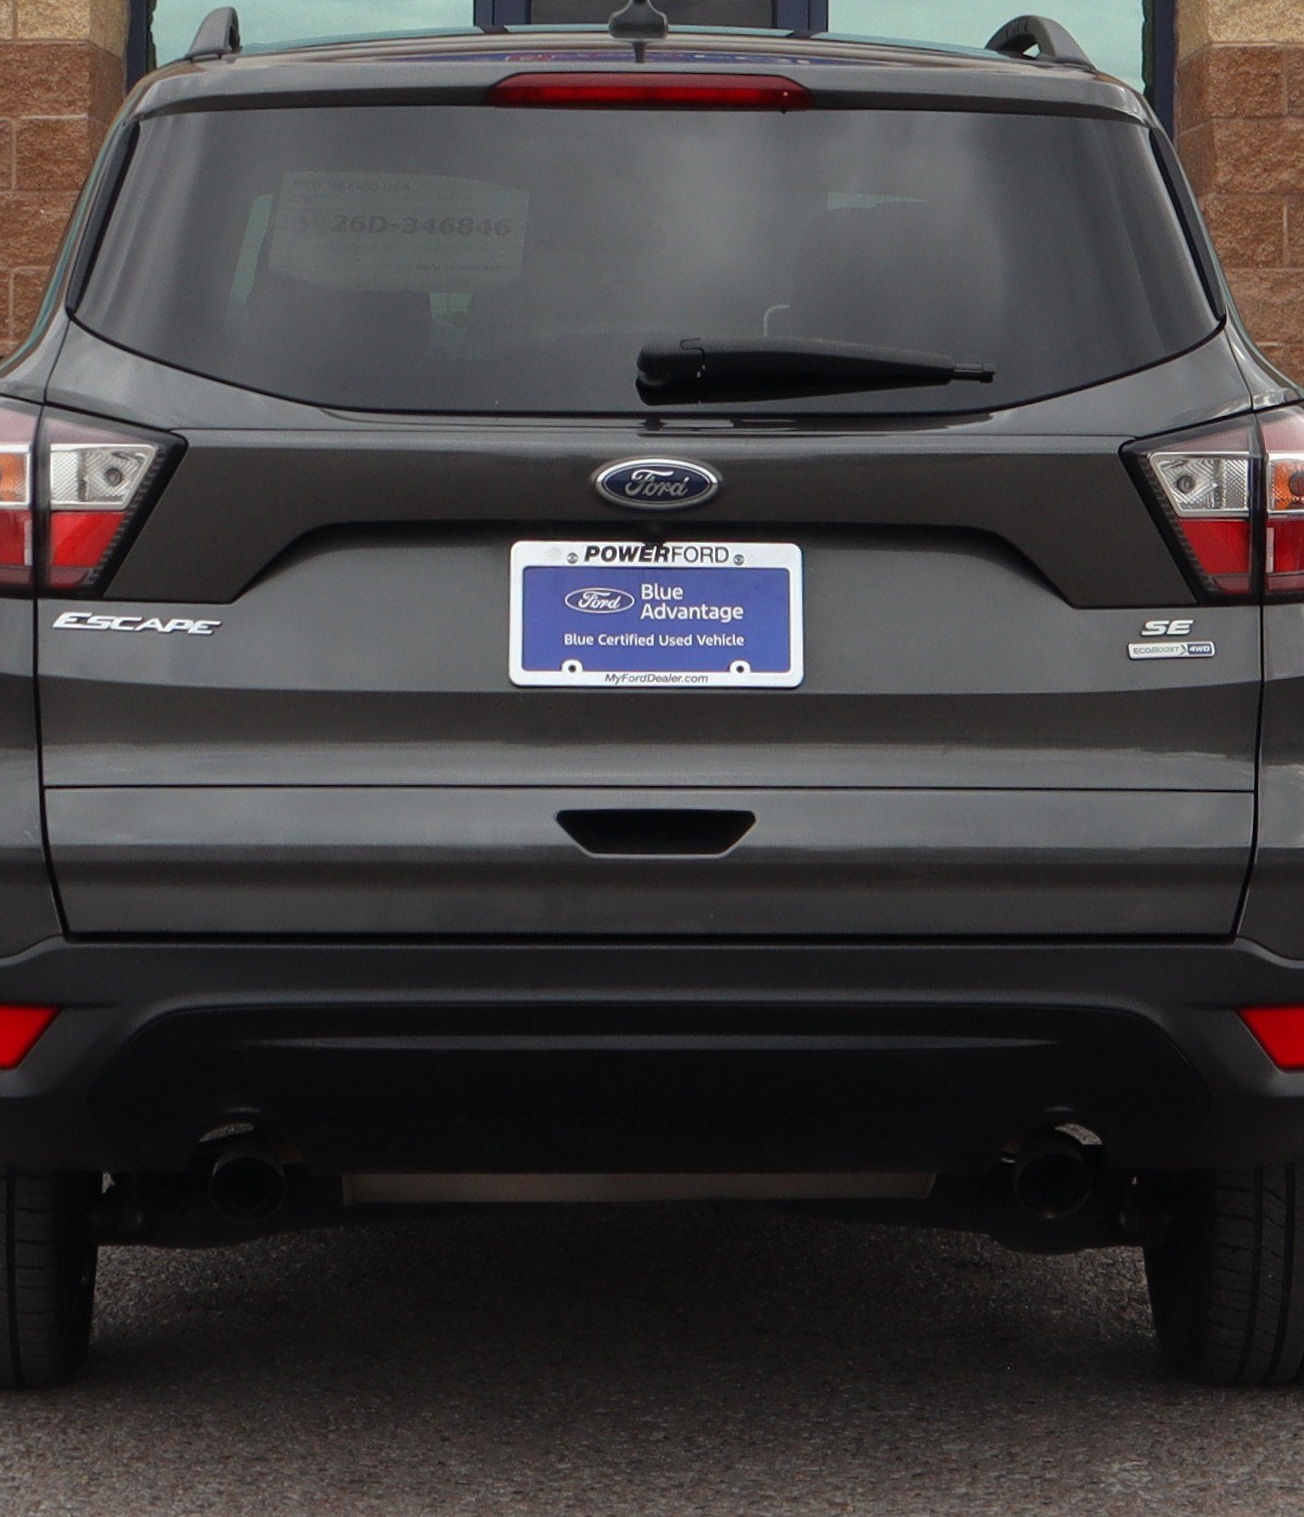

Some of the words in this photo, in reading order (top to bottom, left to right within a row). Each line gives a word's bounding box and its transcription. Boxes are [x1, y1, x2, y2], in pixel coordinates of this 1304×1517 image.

[330, 213, 513, 237] 26D-346846
[624, 469, 689, 497] Ford
[583, 545, 730, 564] POWERFORD
[577, 590, 621, 610] Ford
[640, 583, 684, 601] Blue
[640, 603, 744, 623] Advantage
[52, 611, 222, 635] ESCAPE
[1141, 619, 1194, 636] SE
[564, 633, 595, 646] Blue
[597, 633, 655, 647] Certified
[658, 634, 693, 647] Used
[696, 634, 745, 647] Vehicle
[1189, 645, 1211, 654] 4WD
[604, 673, 709, 685] MyFordDealer.com
